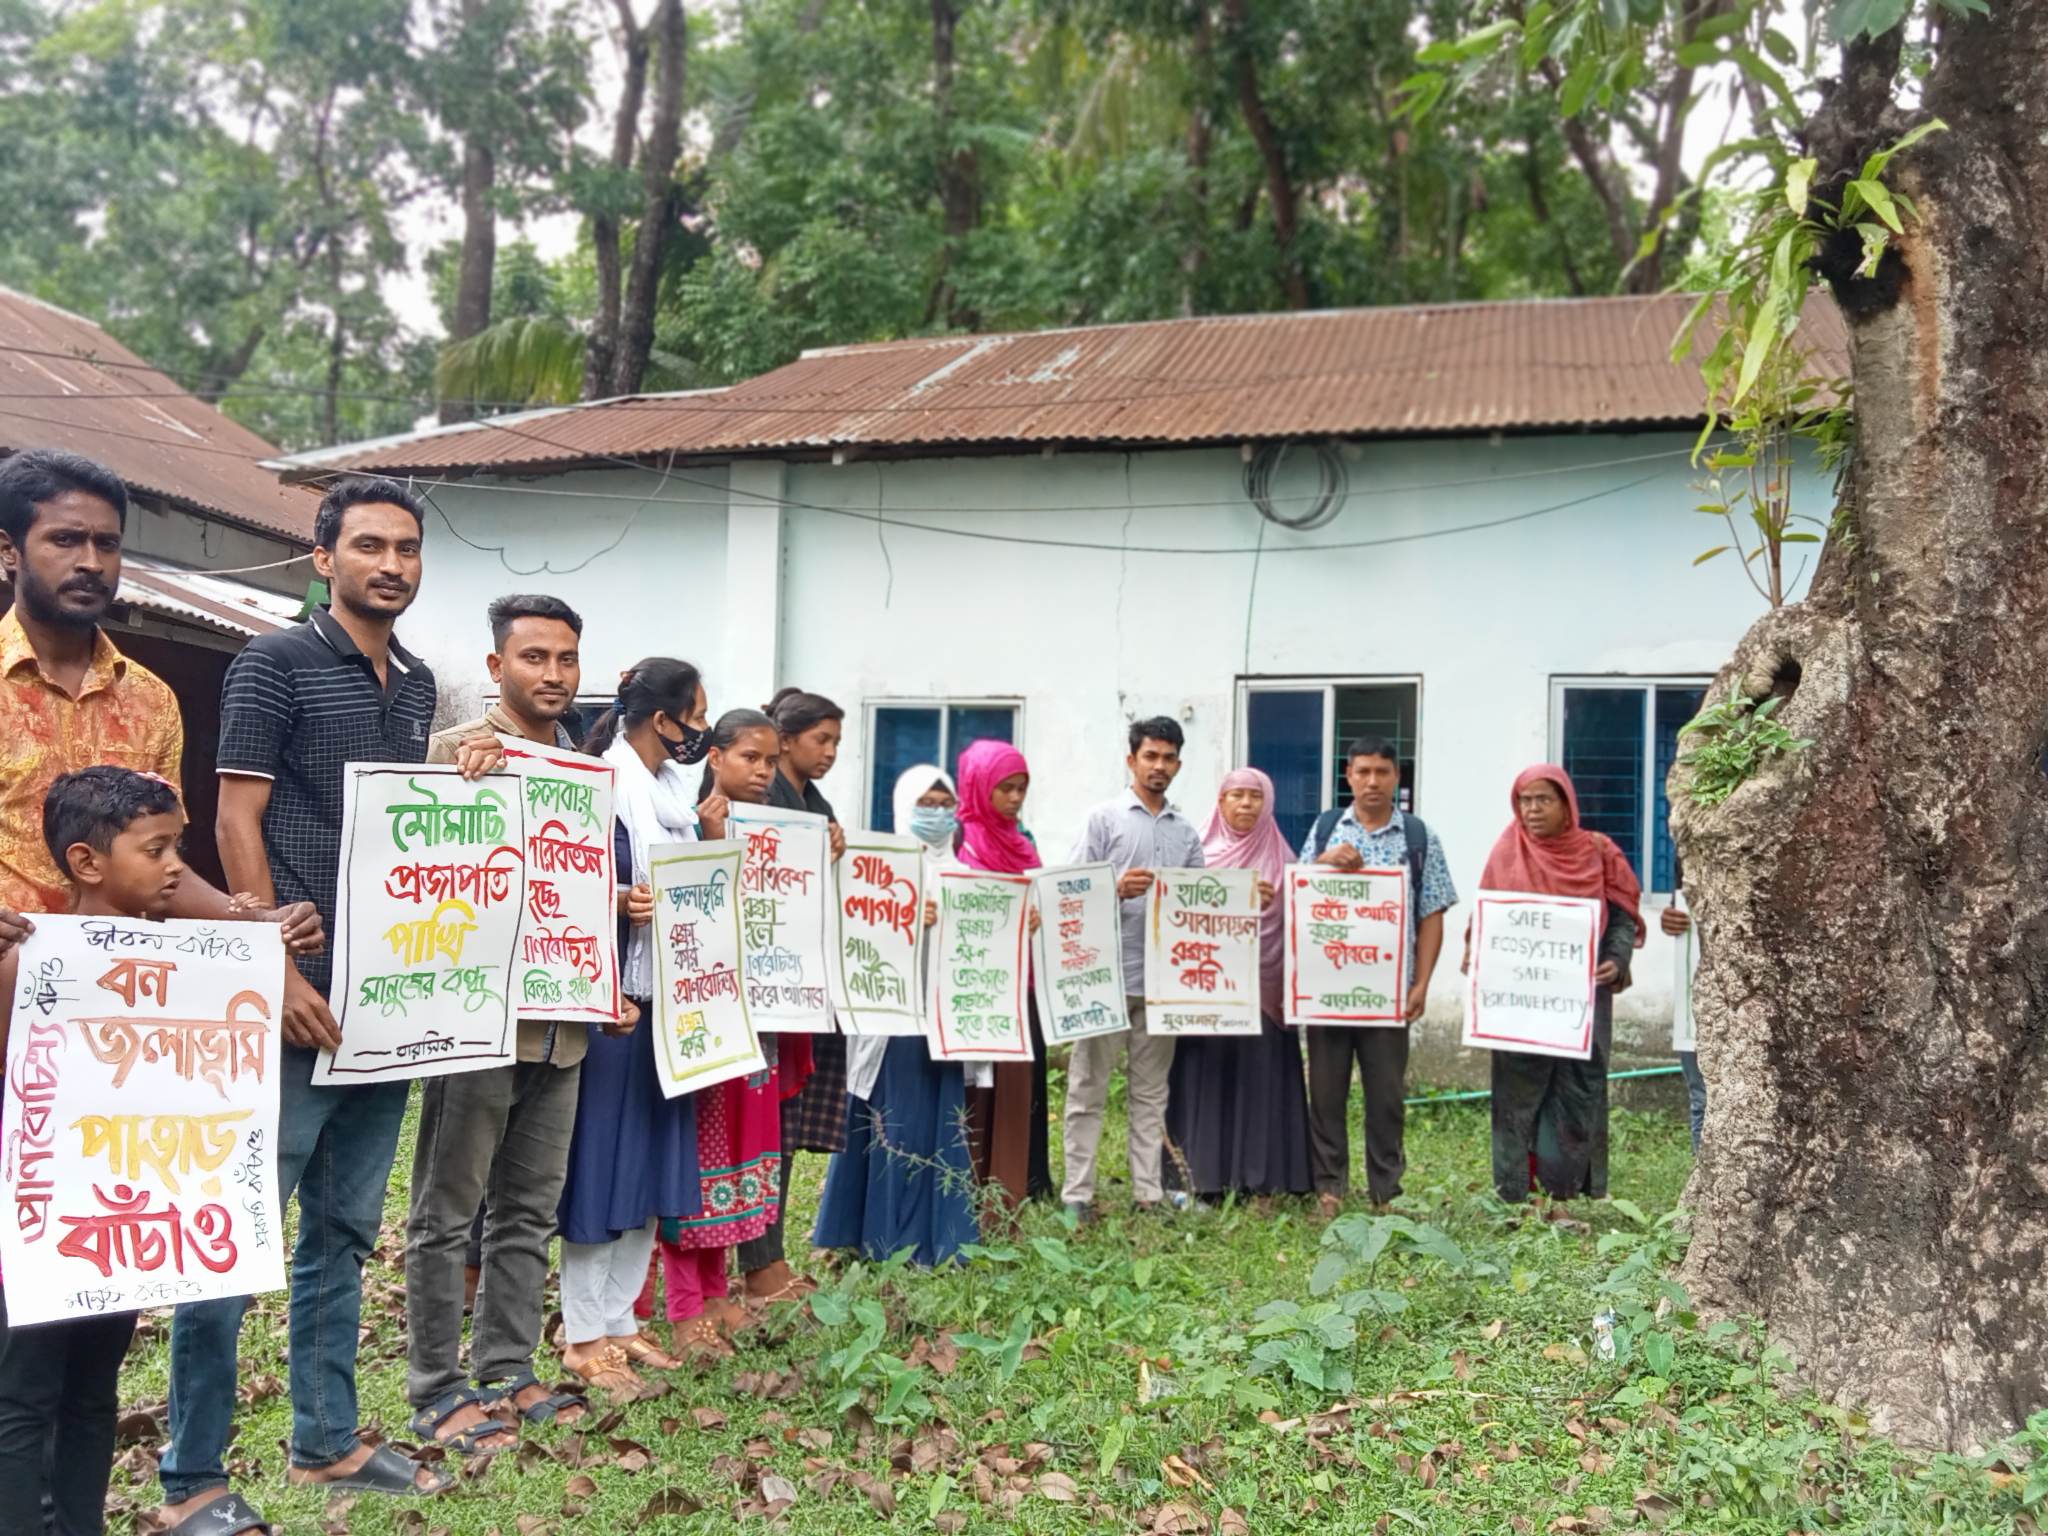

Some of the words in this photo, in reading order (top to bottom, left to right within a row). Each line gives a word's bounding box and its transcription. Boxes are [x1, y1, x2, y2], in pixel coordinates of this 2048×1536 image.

[385, 776, 509, 852] মৌমাছি
[385, 846, 524, 908] প্রজাপতি
[665, 868, 729, 922] জলাভূমি
[852, 855, 897, 898] গাছ
[1174, 876, 1234, 908] হাতির
[1310, 878, 1372, 901] আমরা
[81, 920, 178, 950] জীবন
[383, 899, 478, 967] পাখি
[844, 878, 918, 946] লাগাই
[1507, 909, 1552, 930] SAFE
[96, 958, 178, 1008] বন
[359, 972, 436, 1017] মানুষের
[442, 966, 505, 1013] বন্ধু
[1179, 961, 1224, 993] করি
[1512, 966, 1559, 981] SAFE
[68, 990, 271, 1100] জলাভূমি
[68, 1108, 255, 1197] পাহাড়
[57, 1184, 239, 1278] বাঁচাও
